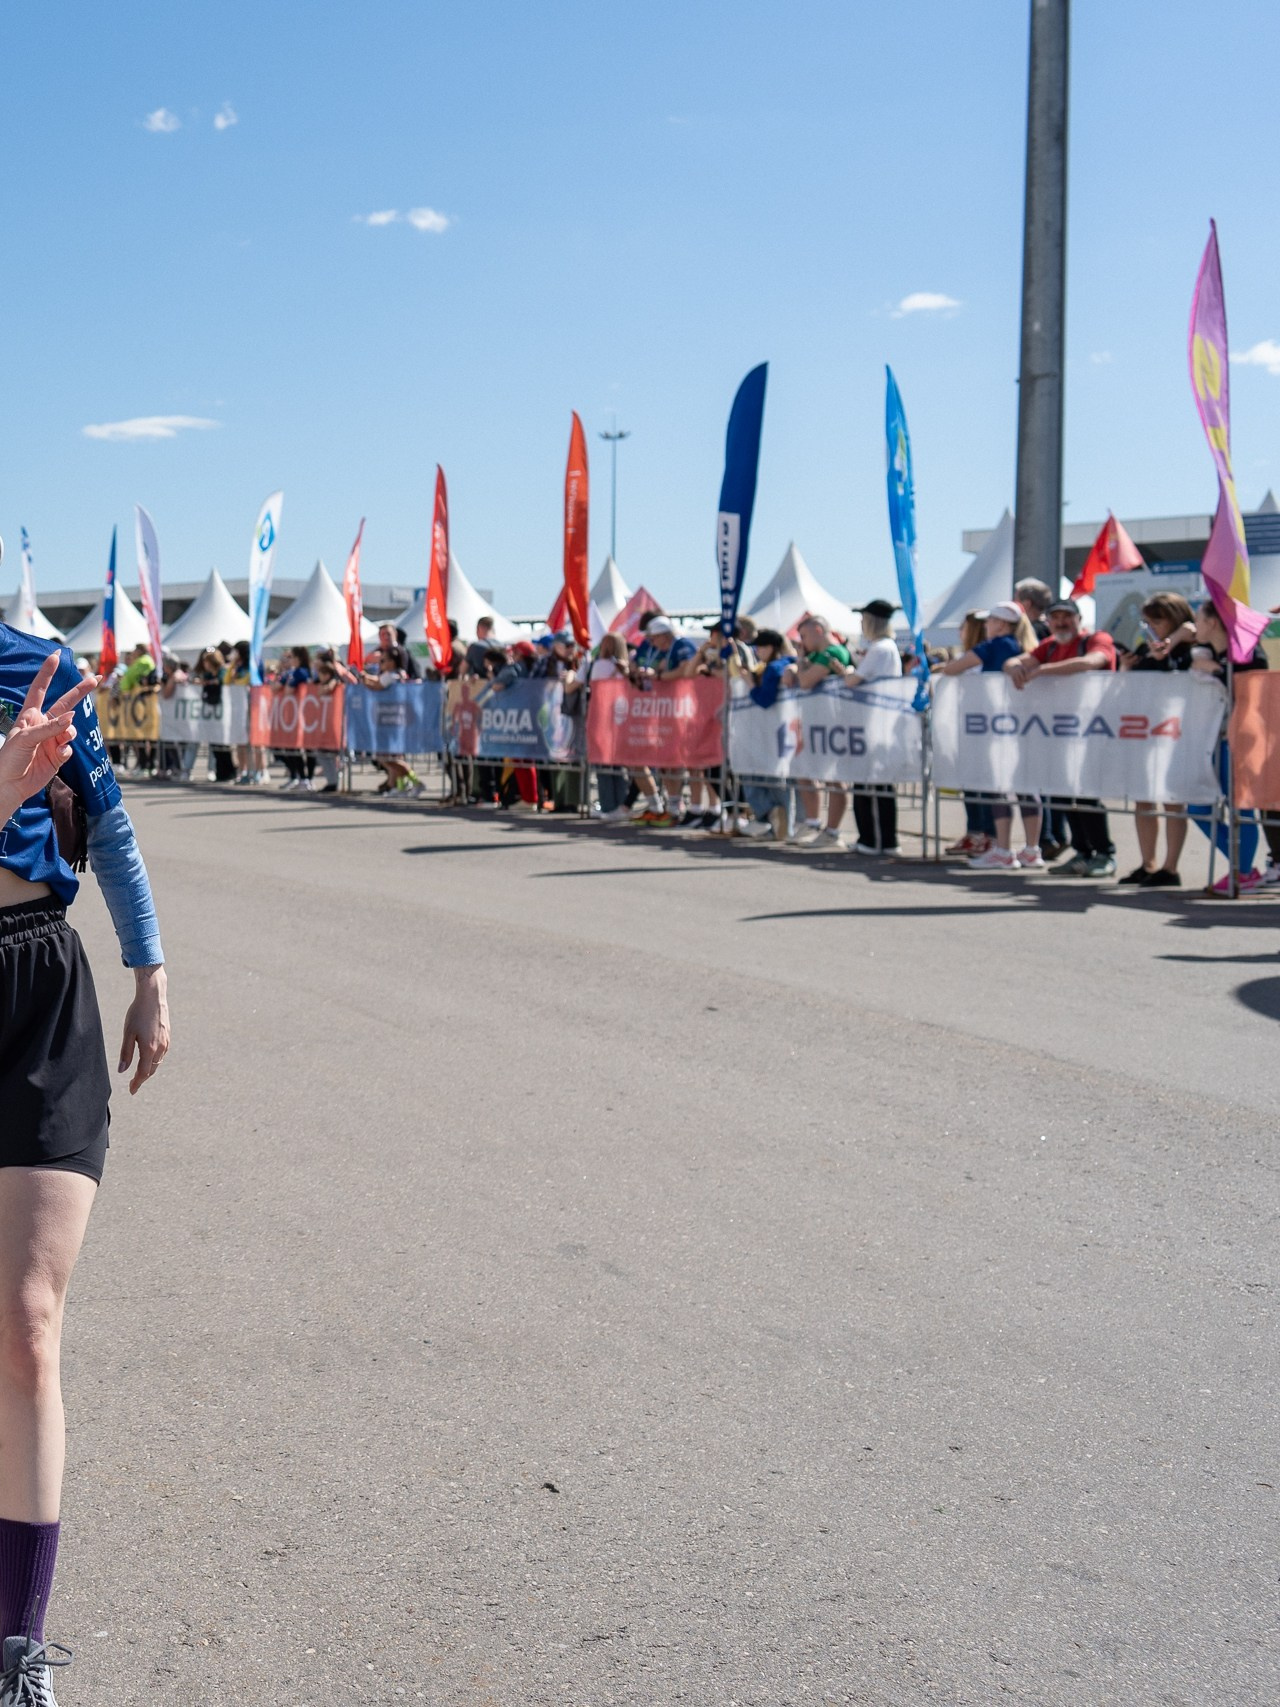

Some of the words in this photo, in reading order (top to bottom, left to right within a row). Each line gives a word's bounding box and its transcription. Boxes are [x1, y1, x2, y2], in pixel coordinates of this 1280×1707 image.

[258, 695, 334, 733] МОСТ
[481, 707, 534, 733] ВОДА
[631, 692, 697, 719] azimut
[809, 725, 868, 756] ПСБ
